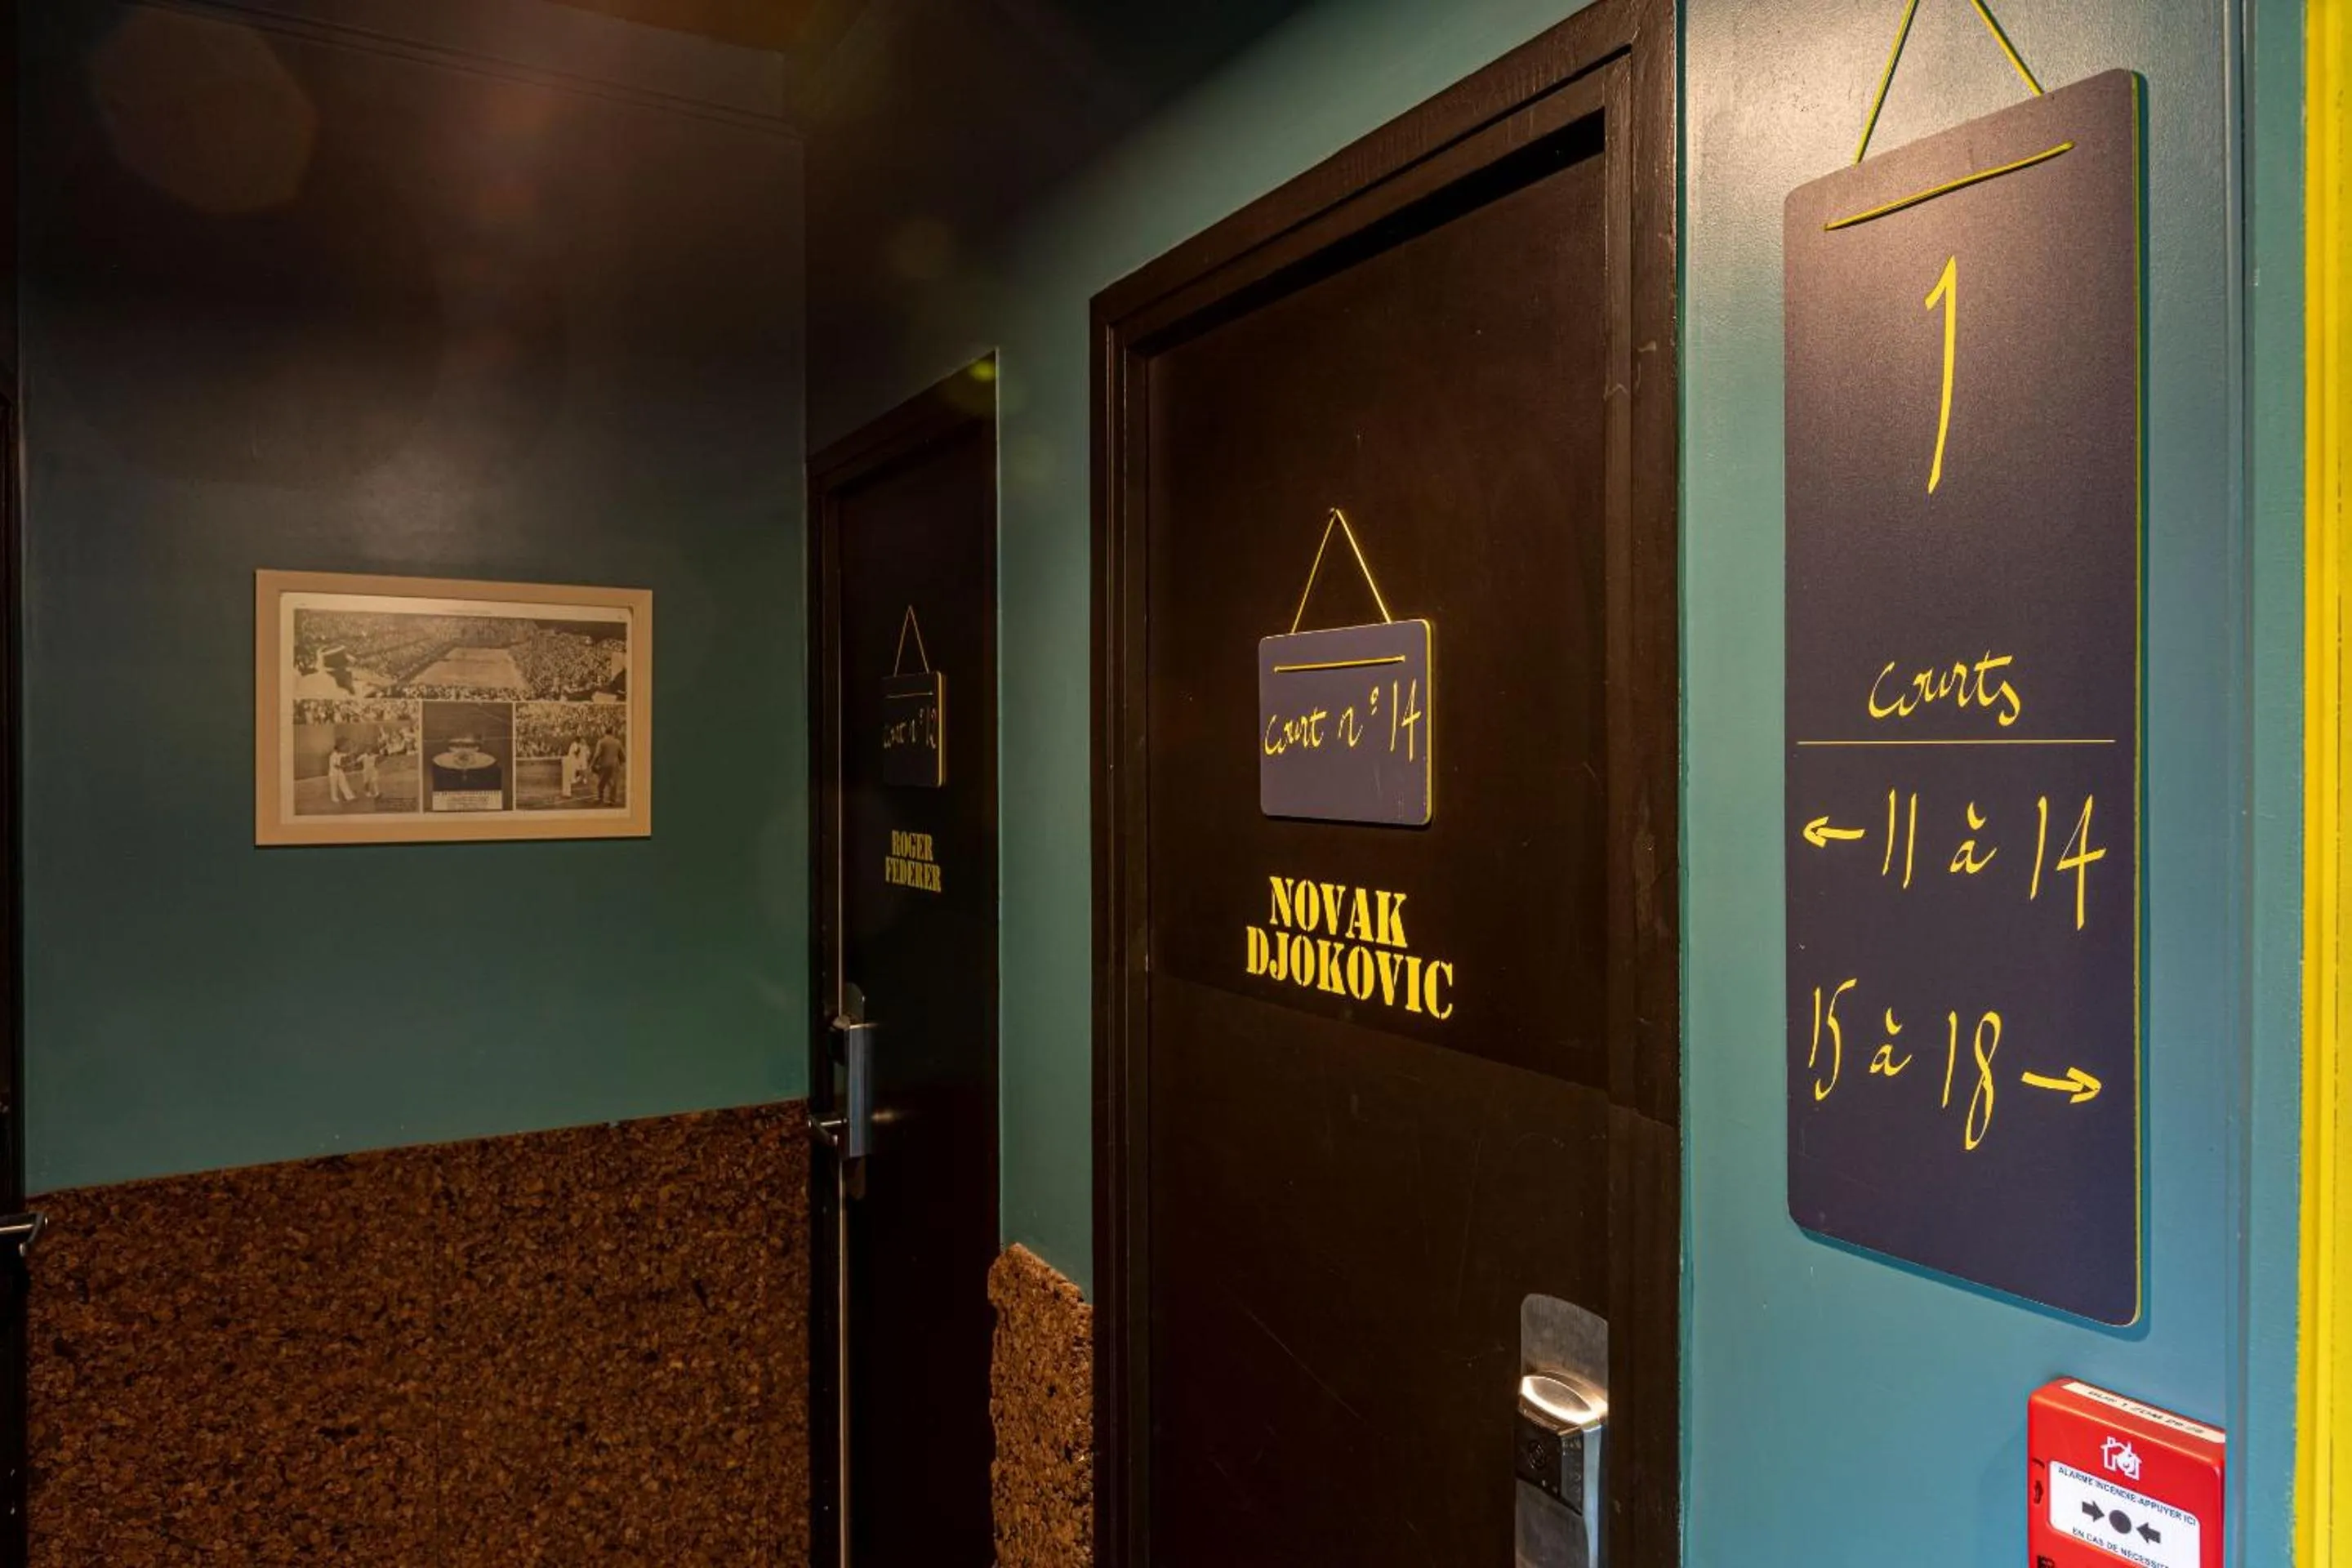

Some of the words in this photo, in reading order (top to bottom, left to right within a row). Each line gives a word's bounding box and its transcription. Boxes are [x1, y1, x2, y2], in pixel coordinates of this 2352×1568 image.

[1925, 255, 1956, 494] 1
[1390, 679, 1421, 762] 14
[885, 856, 941, 893] FEDERER
[891, 829, 933, 862] ROGER
[1882, 790, 1917, 889] 11
[1950, 801, 1998, 873] à
[2030, 795, 2107, 930] 14
[1269, 876, 1407, 948] NOVAK
[1246, 926, 1453, 1019] DJOKOVIC
[1809, 978, 1857, 1101] 15
[1869, 1007, 1913, 1076] à
[1942, 1010, 2002, 1151] 18
[2058, 1467, 2093, 1486] ALARME
[2096, 1480, 2136, 1503] INCENDIE
[2138, 1498, 2182, 1521] APPUYER
[2184, 1515, 2197, 1526] ICI
[2072, 1526, 2084, 1539] EN
[2087, 1534, 2104, 1547] CAS
[2107, 1543, 2118, 1553] DE
